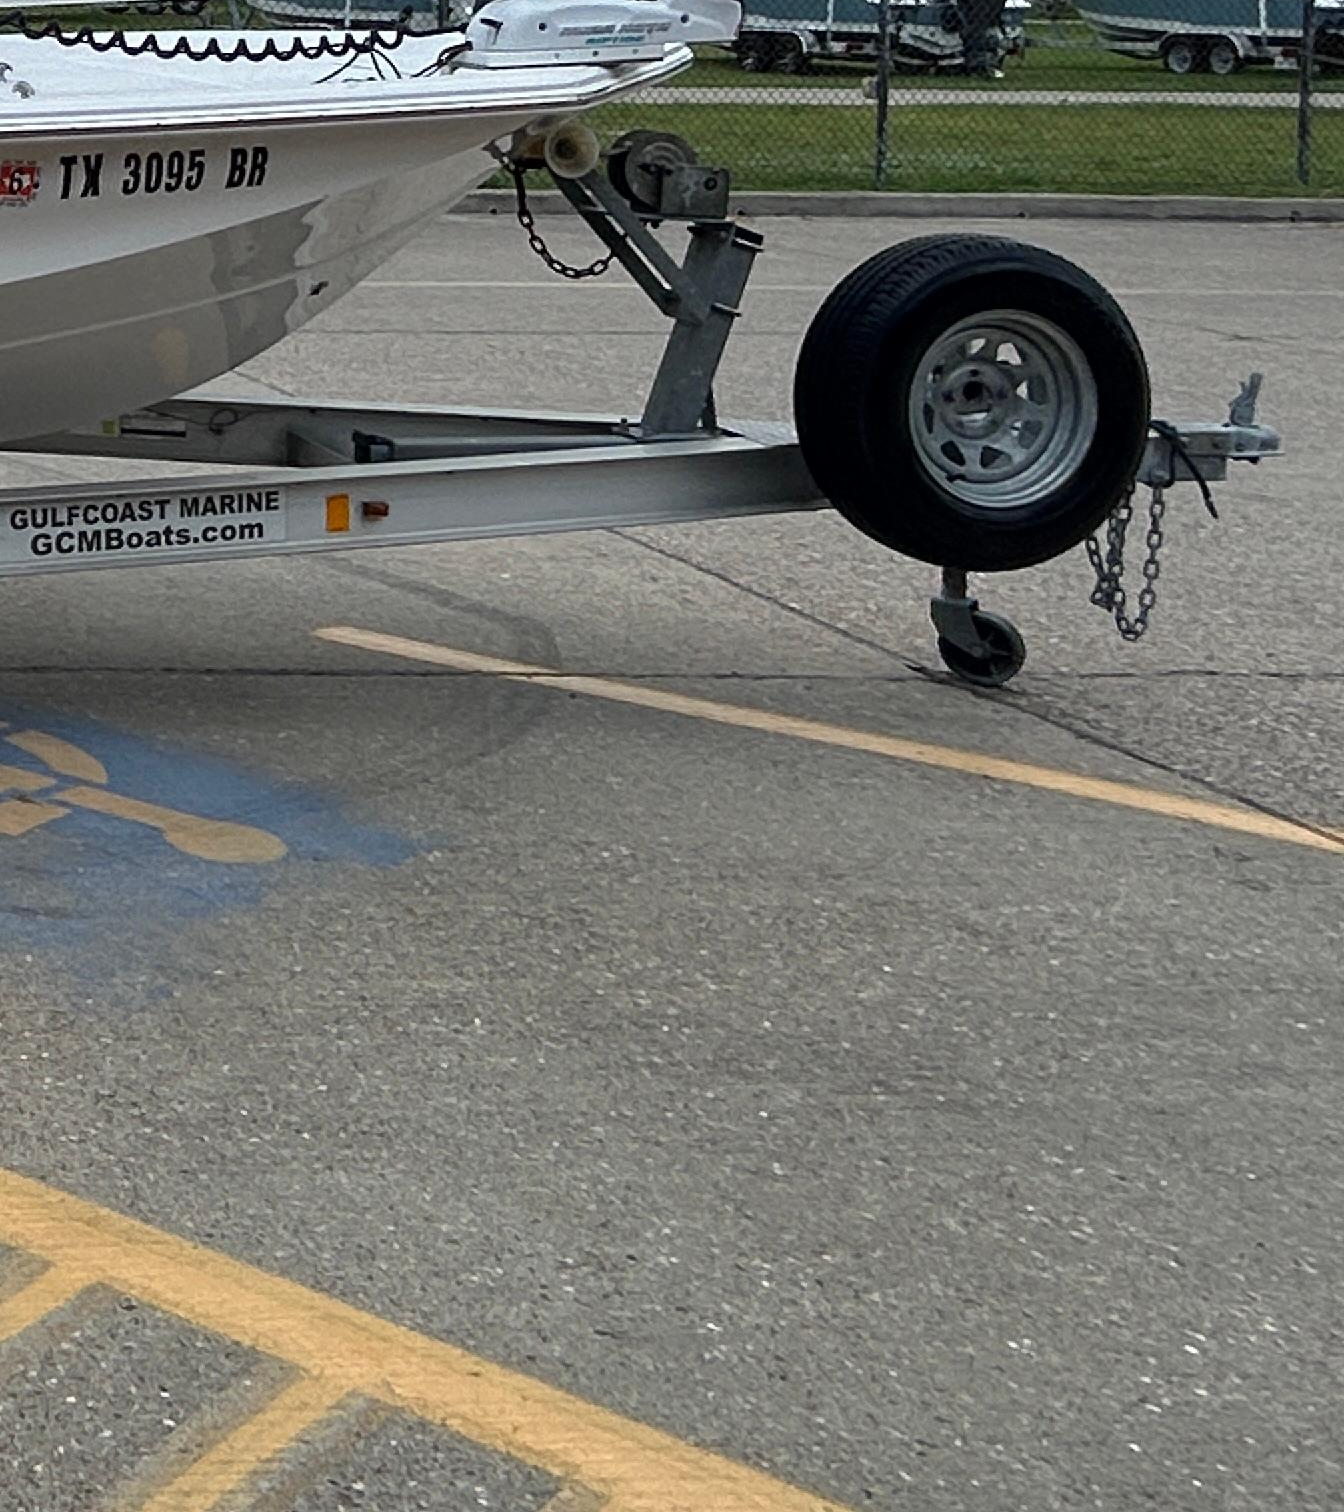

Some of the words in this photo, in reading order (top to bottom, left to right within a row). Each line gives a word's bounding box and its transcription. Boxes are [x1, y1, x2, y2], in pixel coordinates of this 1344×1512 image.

[59, 153, 103, 199] TX
[122, 149, 205, 195] 3095
[225, 146, 269, 189] BR
[10, 499, 171, 530] GULFCOAST
[179, 491, 280, 518] MARINE
[30, 522, 264, 555] GCMBoats.com
